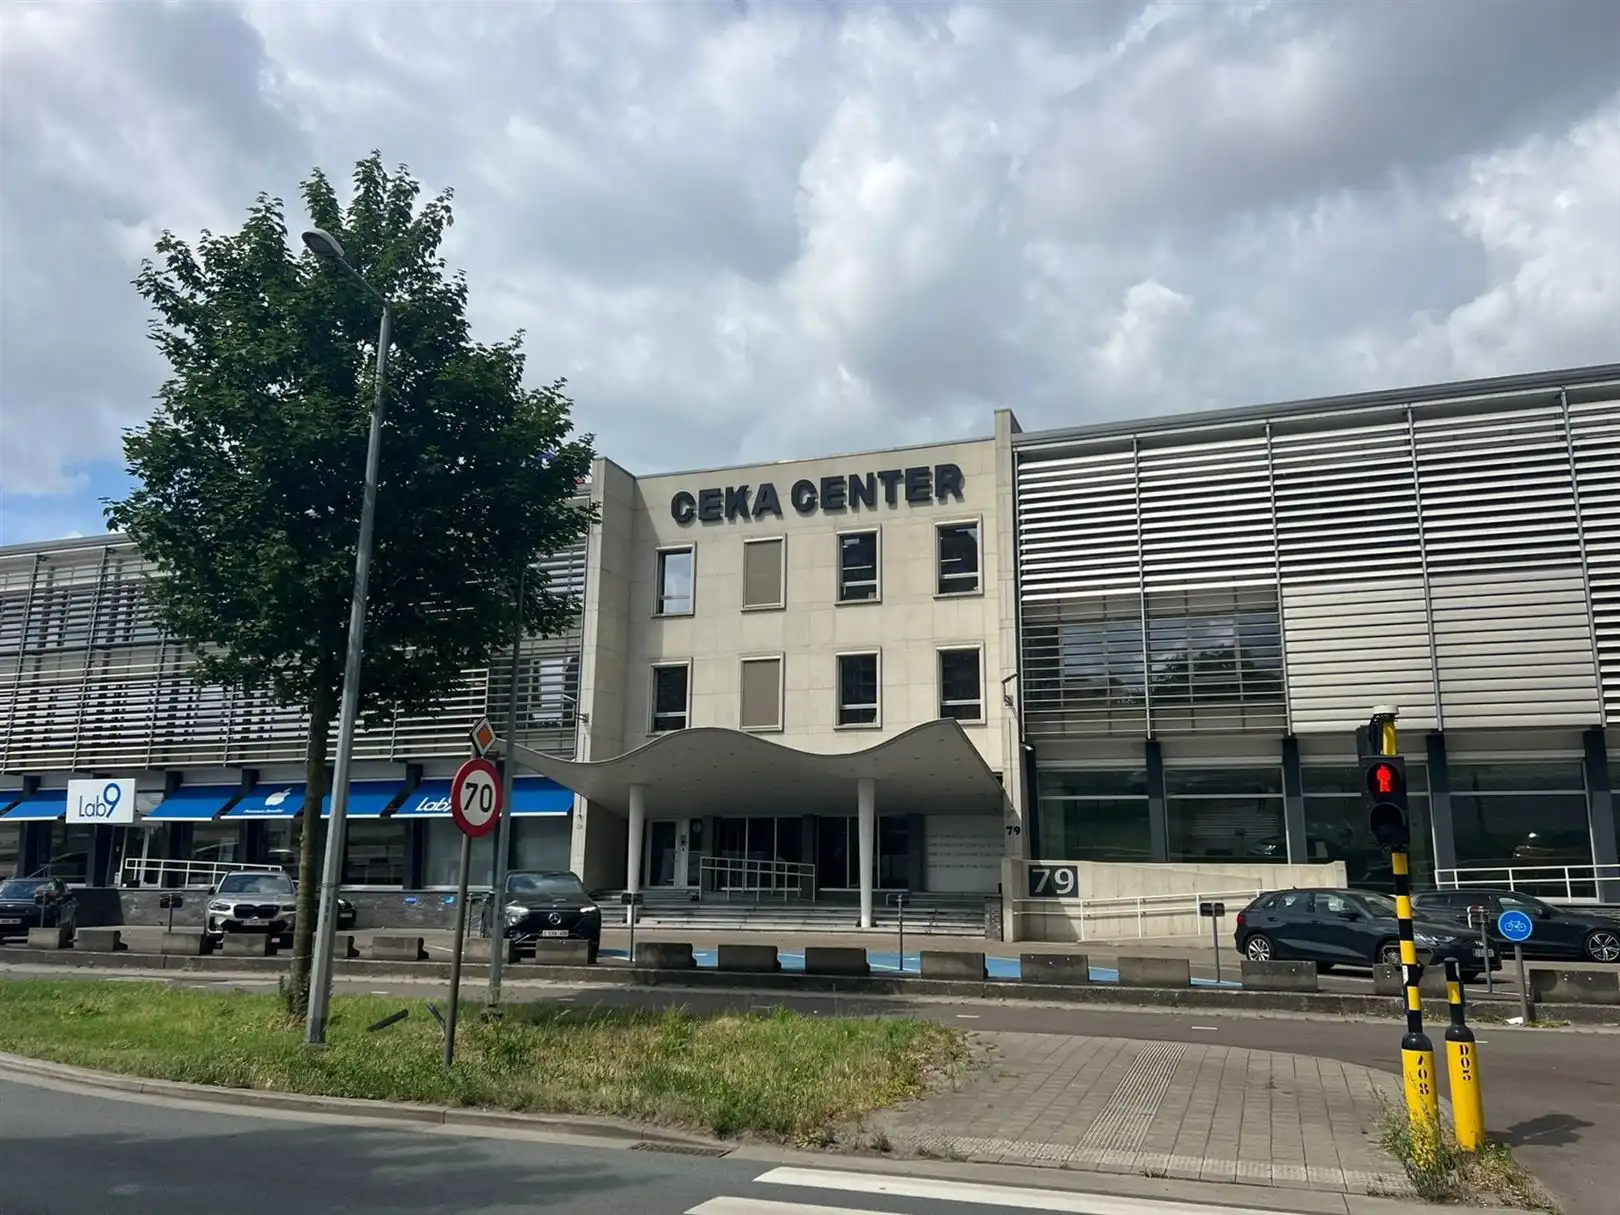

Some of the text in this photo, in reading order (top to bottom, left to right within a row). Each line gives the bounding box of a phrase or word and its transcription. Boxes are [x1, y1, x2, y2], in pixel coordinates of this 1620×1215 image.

[671, 464, 964, 523] CEKA CENTER
[79, 783, 121, 818] Lab9
[464, 782, 493, 813] 70
[1006, 825, 1021, 836] 79
[1032, 868, 1075, 894] 79
